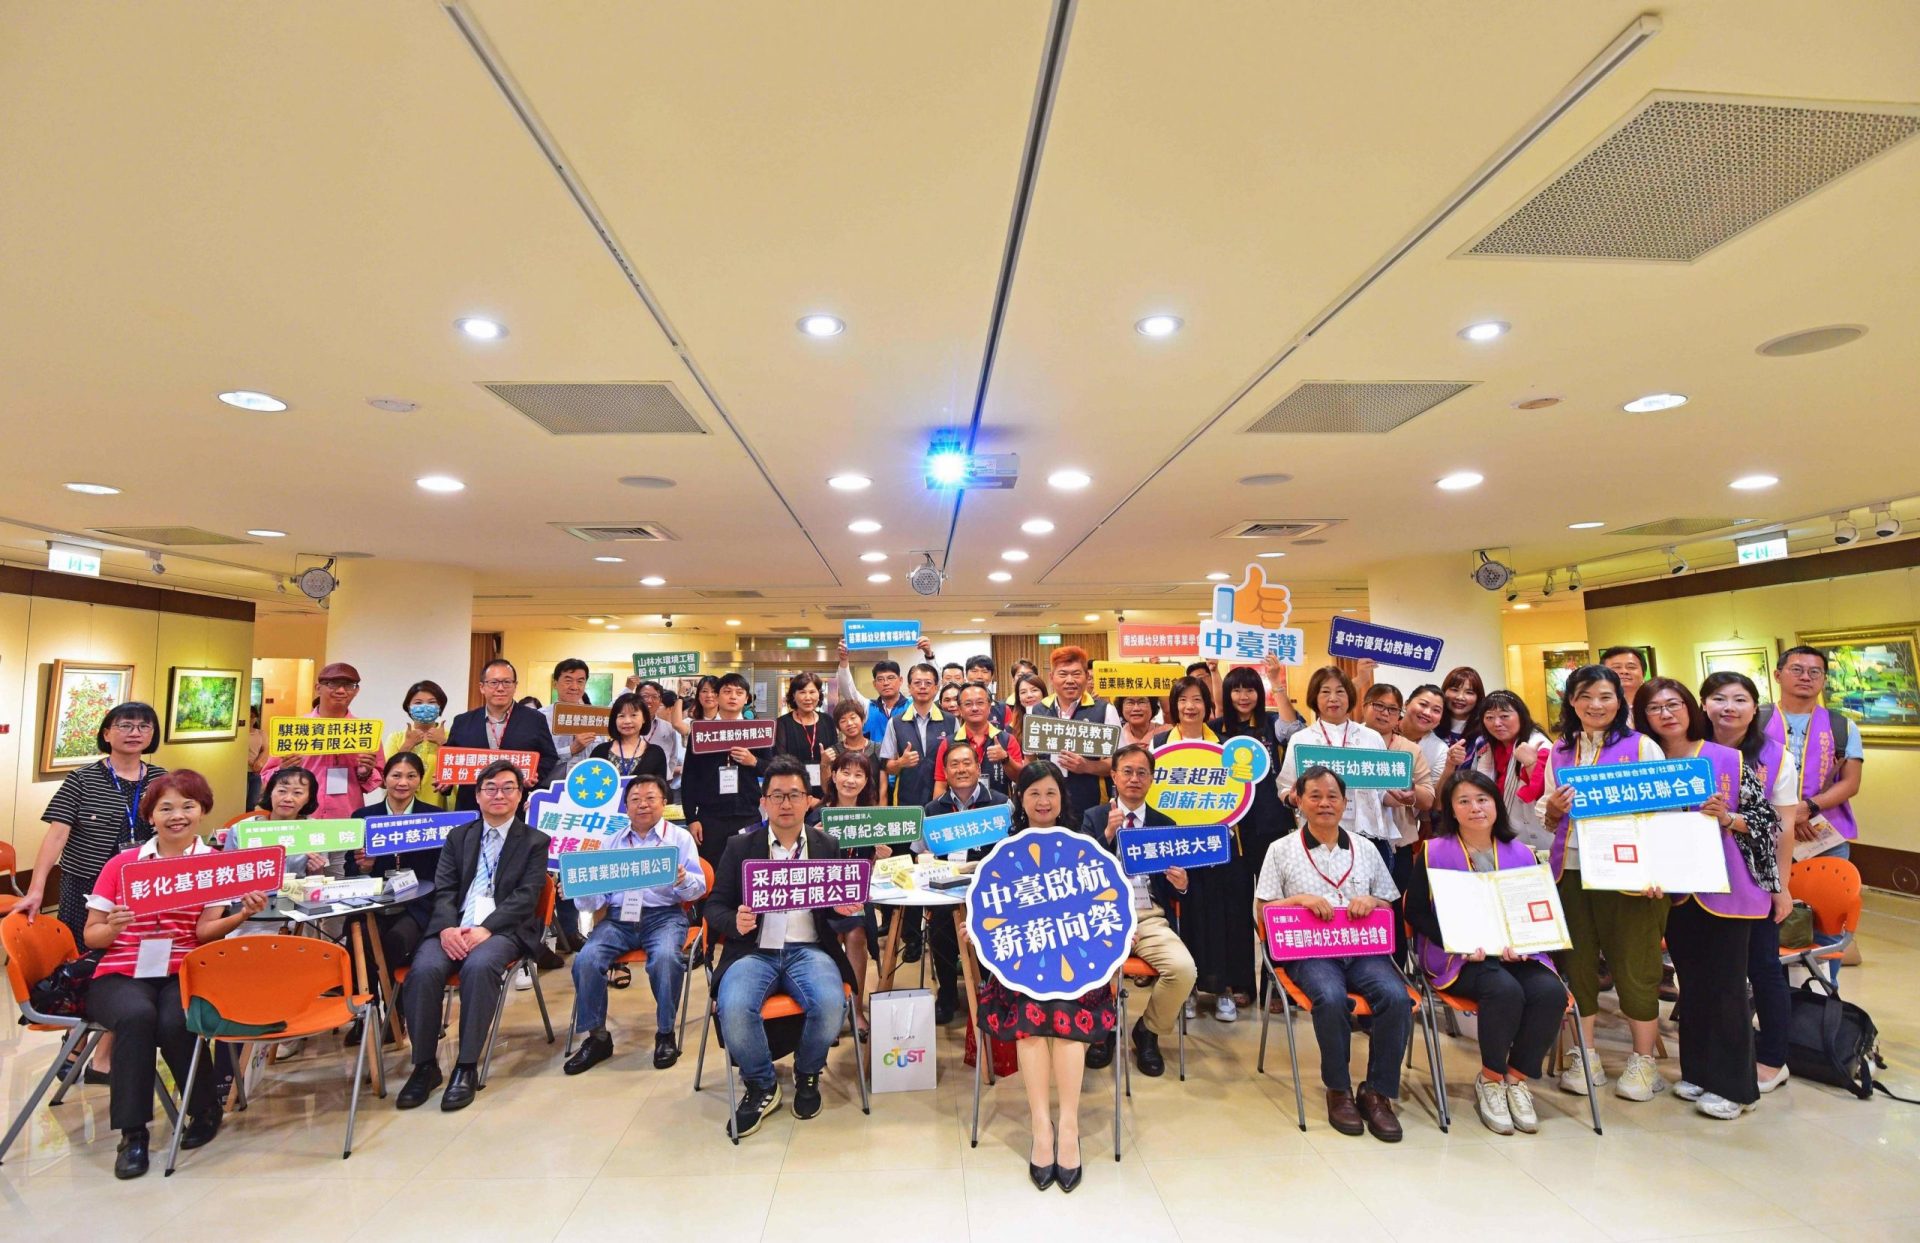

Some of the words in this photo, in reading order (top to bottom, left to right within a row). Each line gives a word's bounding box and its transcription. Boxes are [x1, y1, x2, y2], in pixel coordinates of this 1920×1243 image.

[1123, 634, 1200, 647] 南投縣幼兒教育事業學
[1205, 628, 1297, 662] 中臺讚
[1335, 630, 1434, 661] 臺中市優質幼教聯合會
[637, 653, 695, 667] 山林水環境工程
[638, 663, 696, 677] 股份有限公司
[695, 726, 773, 743] 和大工業股份有限公司
[1030, 721, 1114, 741] 台中市幼兒教育
[276, 737, 372, 752] 股份有限公司
[1028, 735, 1113, 755] 暨福利協會
[1153, 767, 1228, 786] 中臺起飛
[1158, 791, 1238, 810] 創薪未來
[1573, 774, 1706, 808] 台中嬰幼兒聯合會
[371, 824, 462, 848] 台中慈濟醫
[828, 820, 917, 840] 秀傳紀念醫院
[929, 815, 1006, 844] 中臺科技大學
[1126, 835, 1223, 861] 中臺科技大學
[130, 859, 276, 901] 彰化基督教醫院
[567, 857, 671, 884] 惠民實業股份有限公司
[752, 864, 861, 888] 采威國際資訊
[752, 883, 861, 908] 股份有限公司
[989, 901, 1124, 962] 薪薪向榮
[1275, 926, 1388, 949] 中華國際幼兒文教聯合總會
